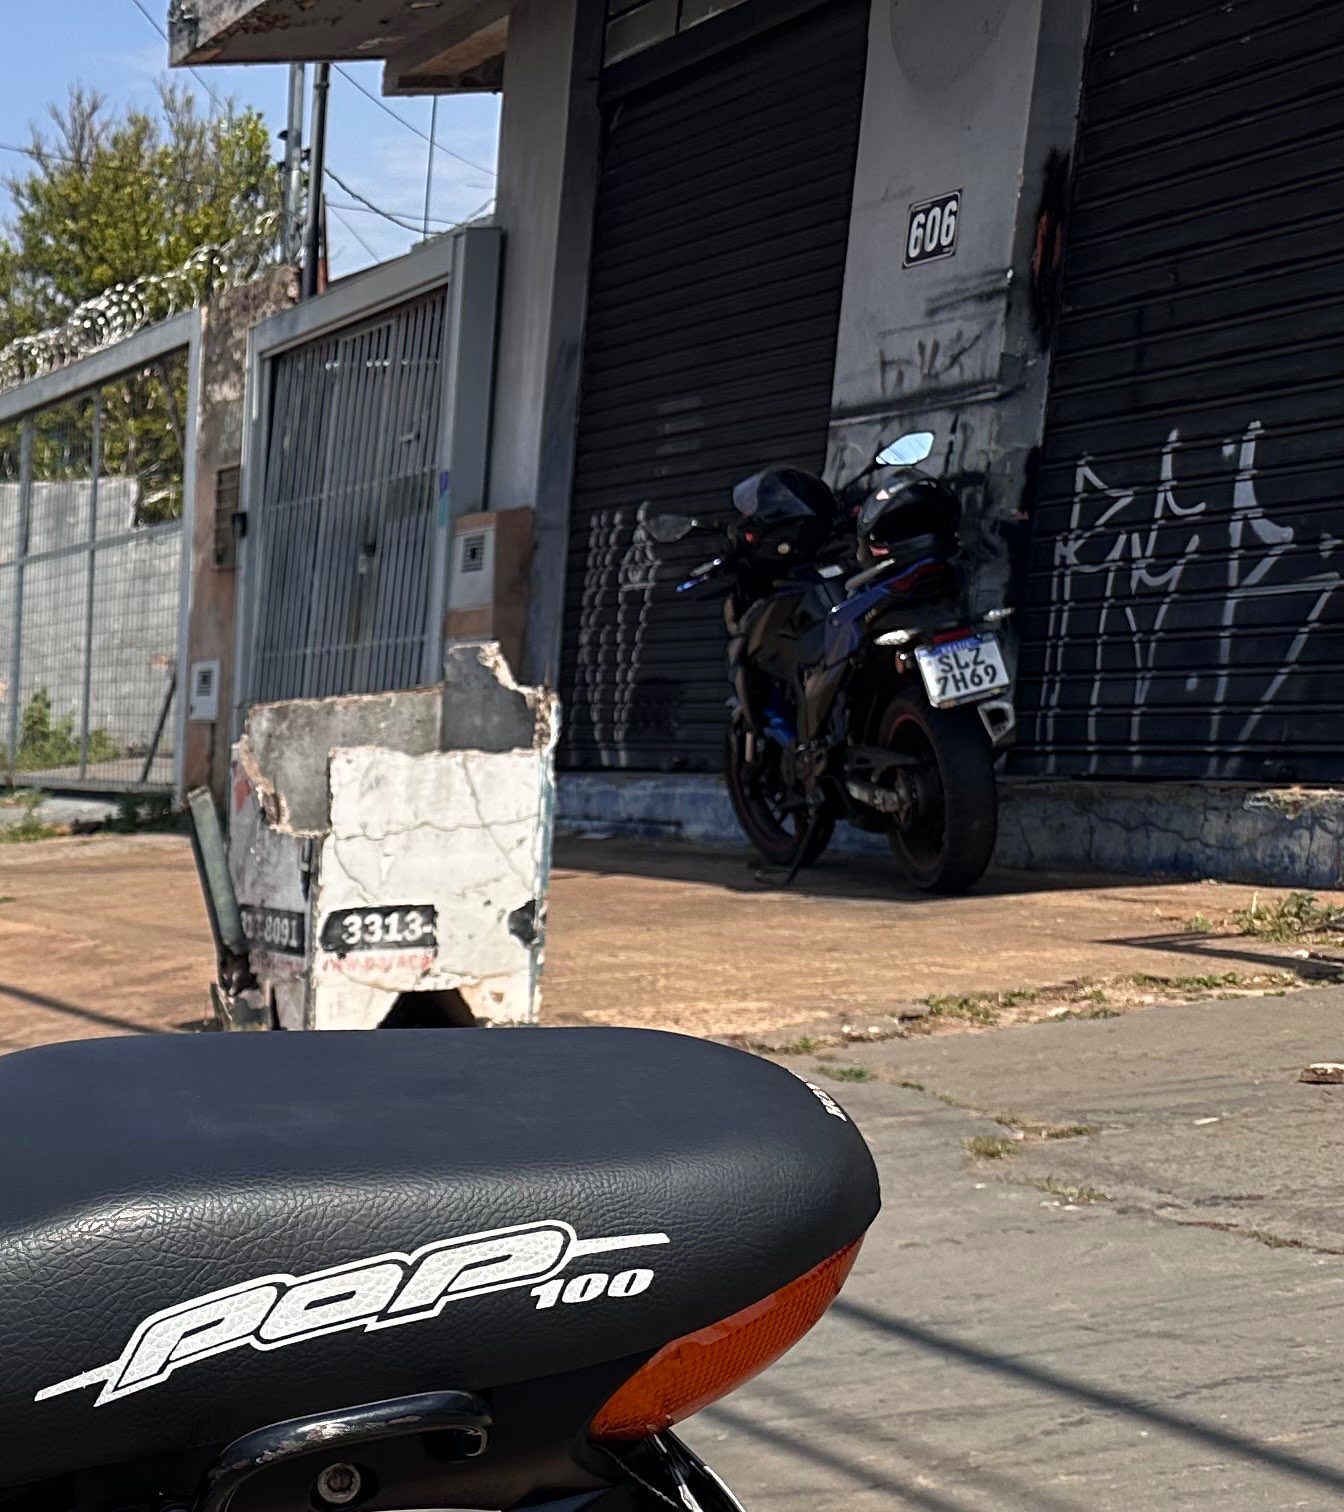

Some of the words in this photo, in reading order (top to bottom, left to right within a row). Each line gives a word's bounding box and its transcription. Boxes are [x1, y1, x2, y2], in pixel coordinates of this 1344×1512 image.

[908, 200, 957, 258] 606
[937, 647, 986, 673] SLZ
[937, 664, 997, 696] 7H69
[530, 1268, 655, 1311] 100
